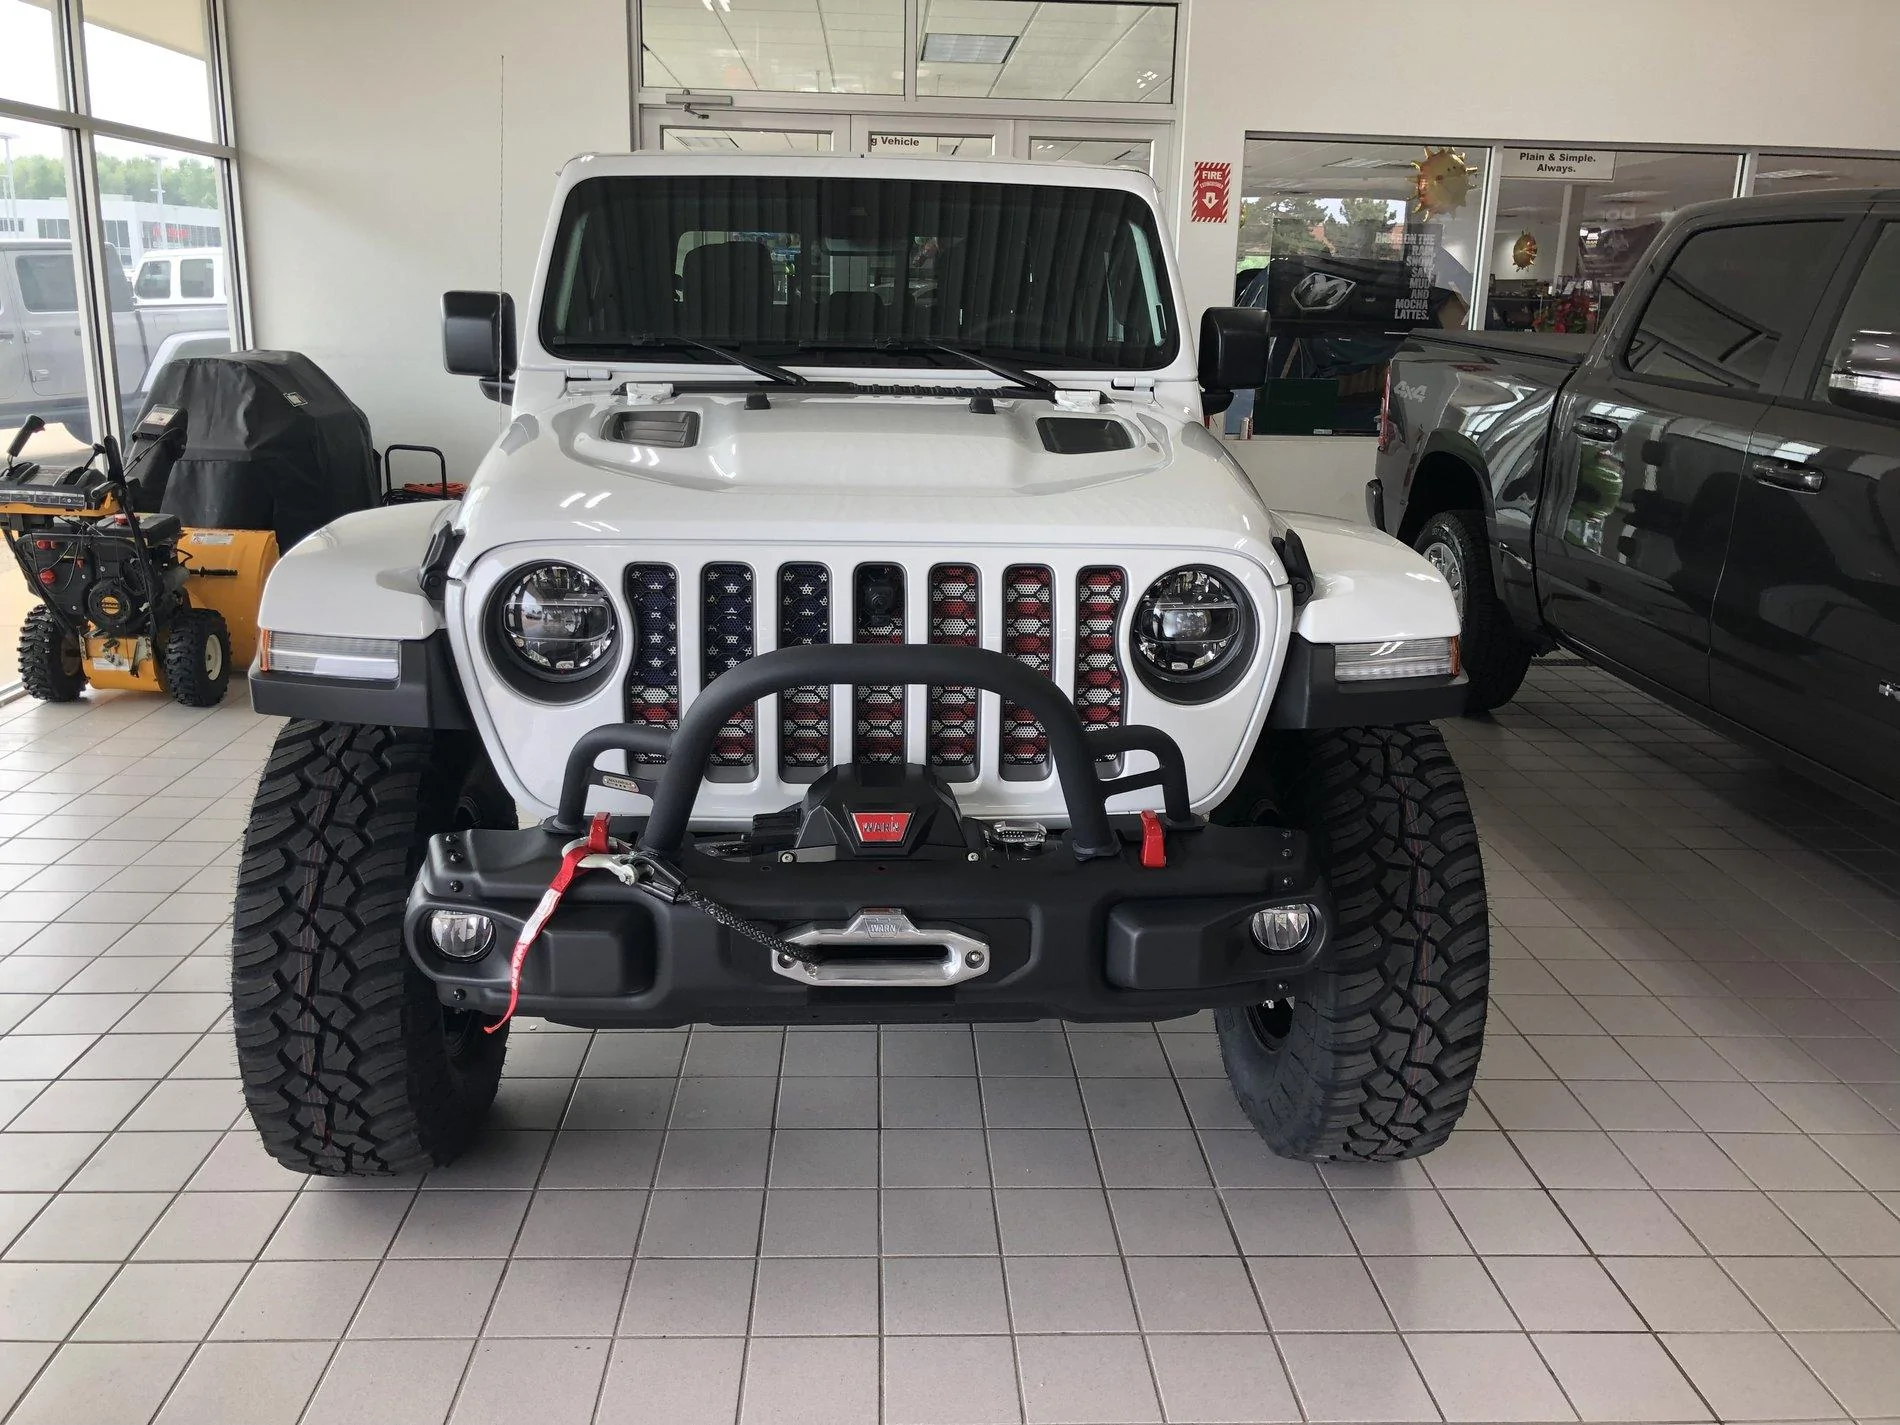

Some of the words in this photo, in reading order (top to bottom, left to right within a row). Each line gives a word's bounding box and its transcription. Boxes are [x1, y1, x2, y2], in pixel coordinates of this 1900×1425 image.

[881, 136, 919, 146] Vehicle
[1520, 152, 1545, 161] Plain
[1548, 153, 1555, 161] &
[1559, 153, 1596, 163] Simple.
[1537, 163, 1576, 174] Always.
[1202, 171, 1223, 180] FIRE
[1404, 233, 1417, 244] ON
[1418, 234, 1435, 244] THE
[1409, 278, 1430, 288] MUD
[1410, 289, 1430, 299] AND
[1395, 299, 1428, 310] MOCHA
[1394, 309, 1430, 320] LATTES.
[862, 822, 900, 833] WARN
[870, 924, 896, 932] WARN
